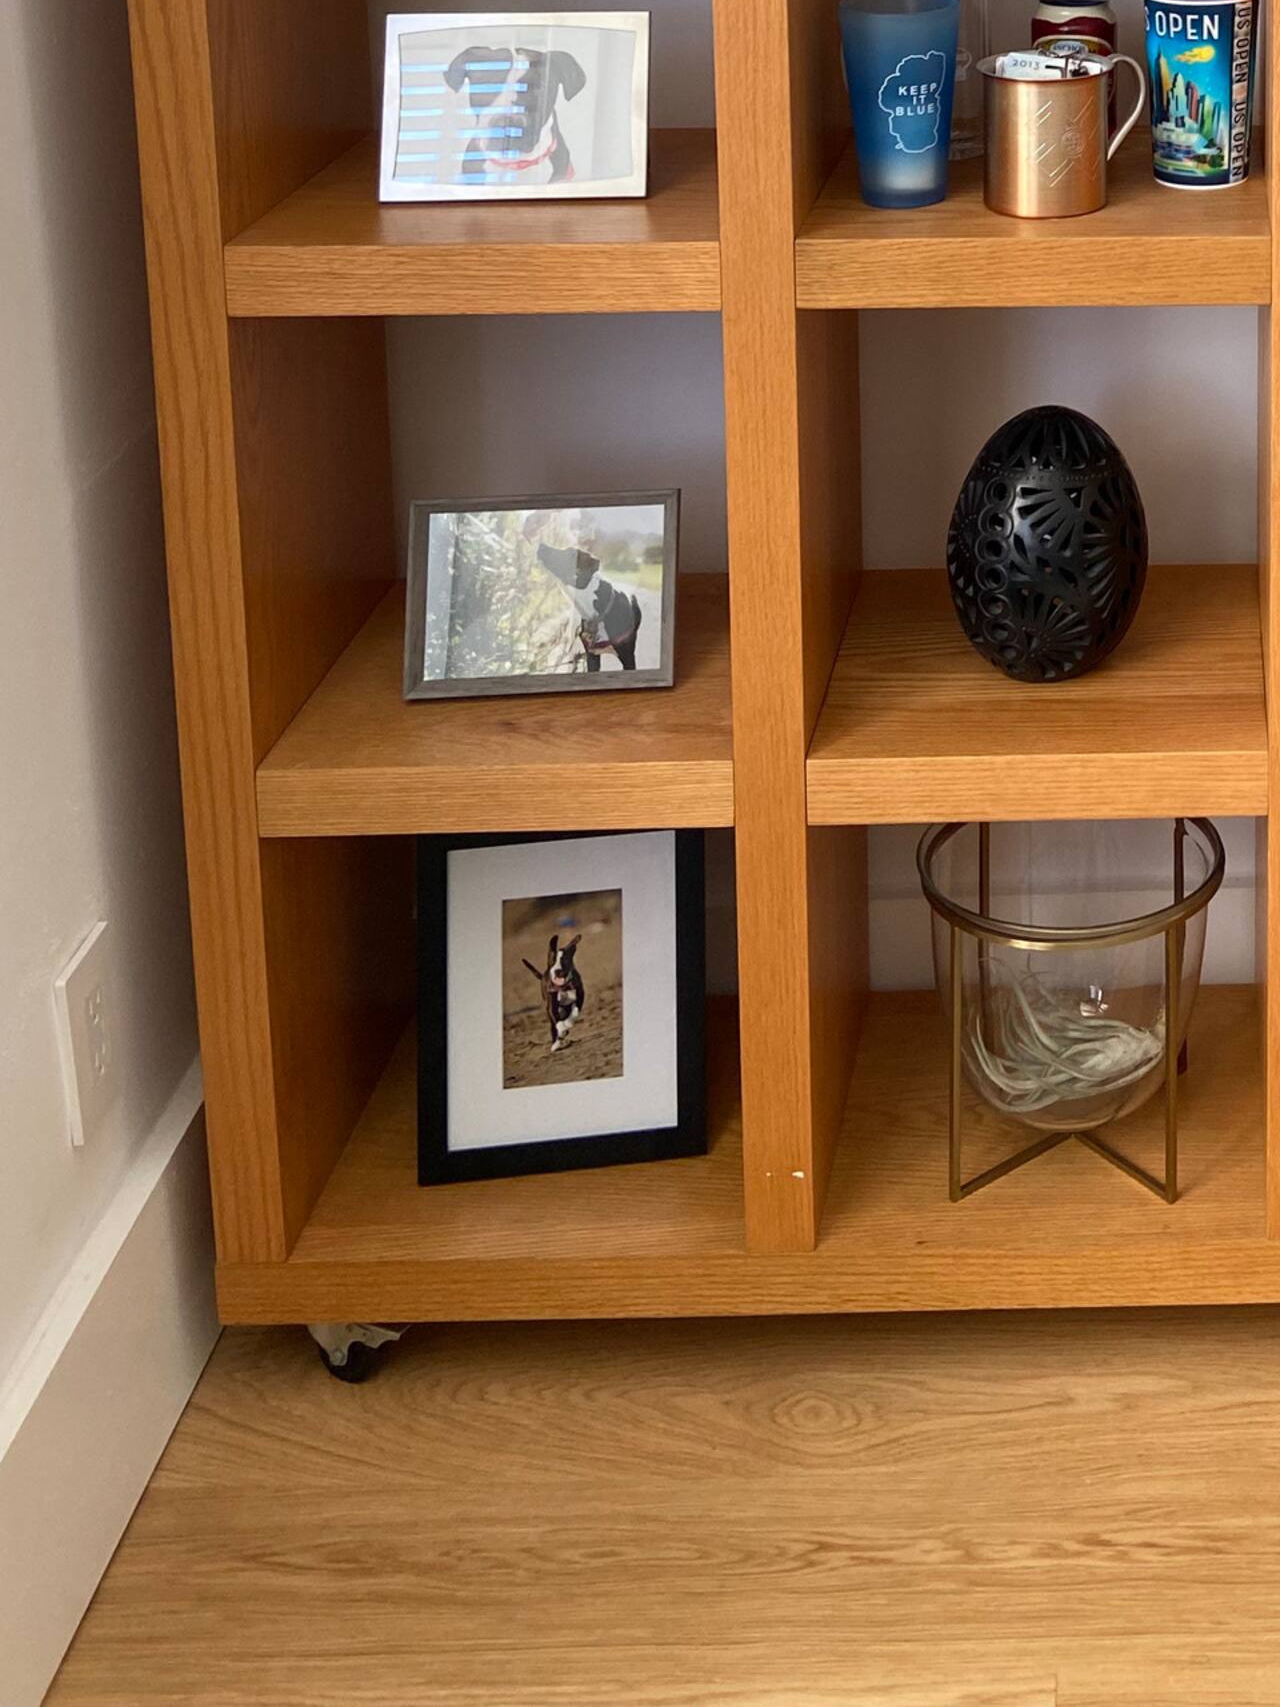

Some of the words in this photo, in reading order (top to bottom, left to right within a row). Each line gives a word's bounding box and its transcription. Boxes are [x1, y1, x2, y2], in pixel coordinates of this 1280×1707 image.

[1155, 10, 1220, 40] OPEN
[1236, 6, 1250, 30] US
[1235, 37, 1249, 84] OPEN
[898, 82, 938, 96] KEEP
[912, 95, 926, 105] IT
[895, 102, 936, 116] BLUE
[1233, 101, 1246, 125] US
[1231, 132, 1246, 177] OPEN
